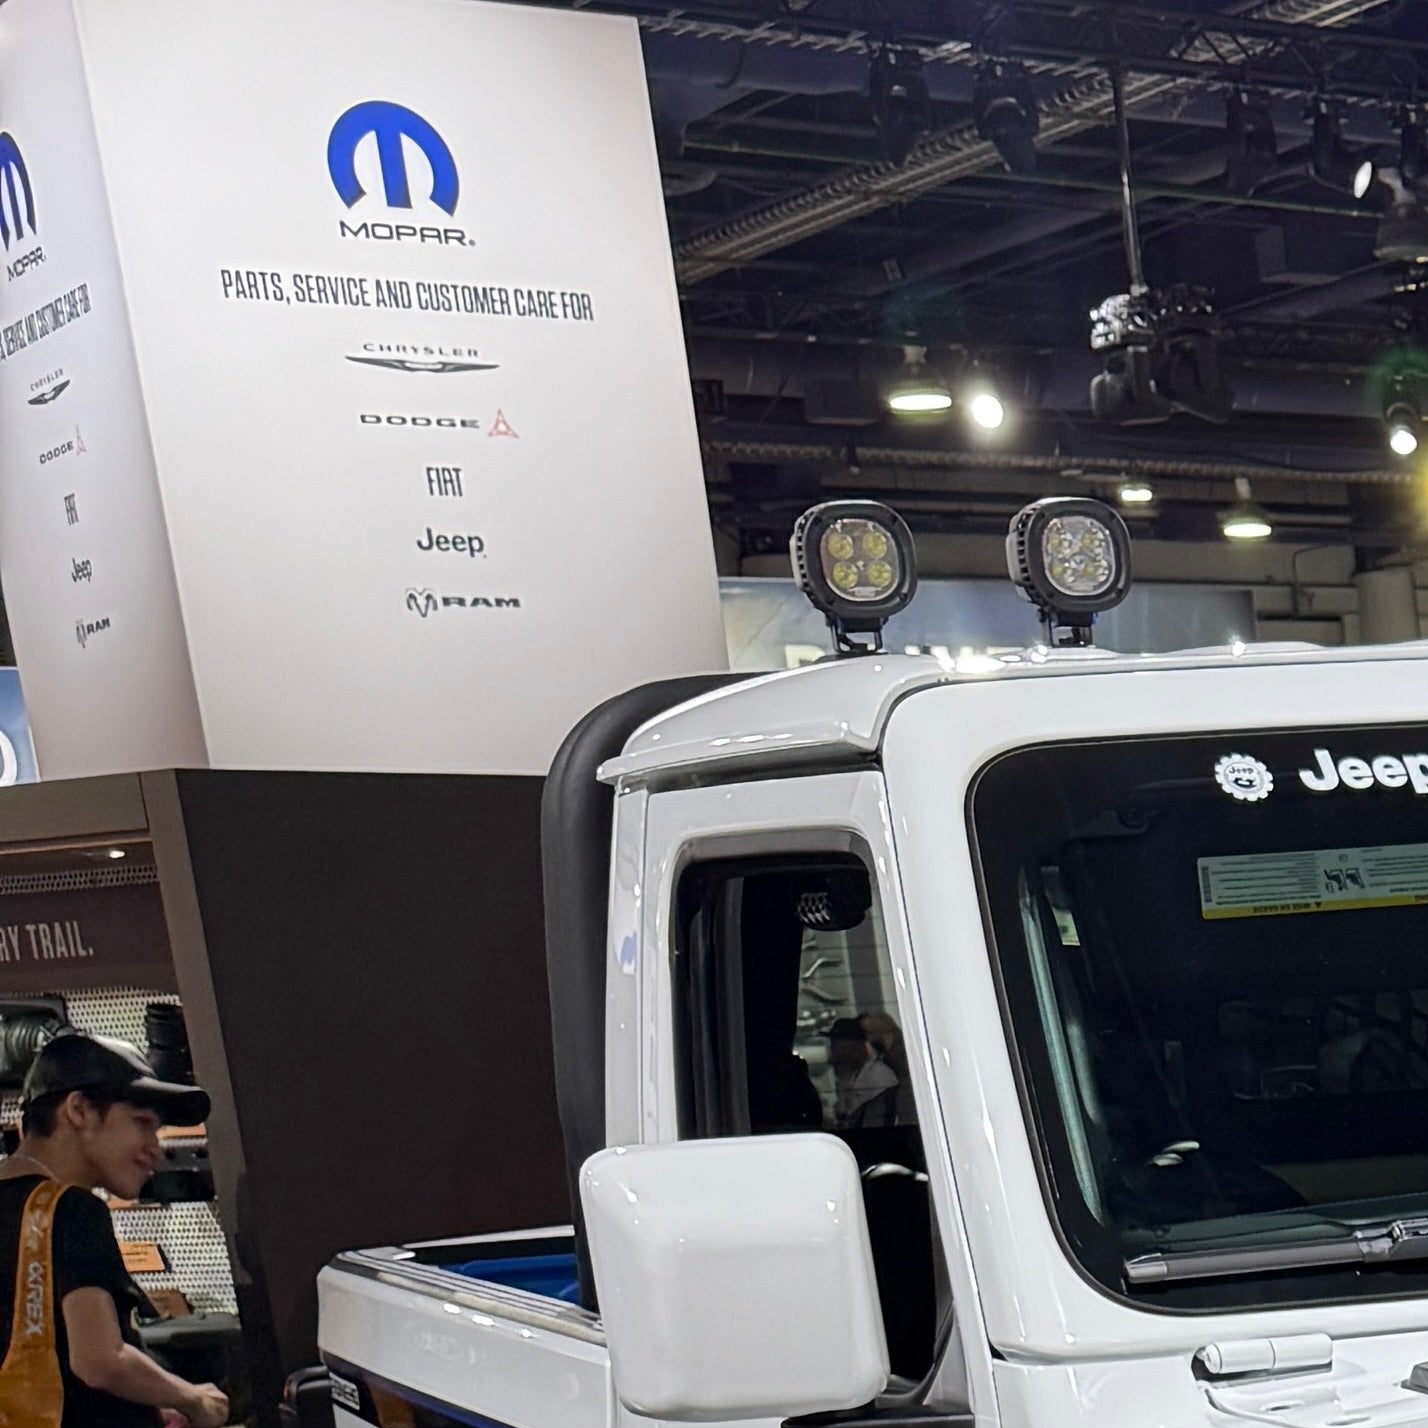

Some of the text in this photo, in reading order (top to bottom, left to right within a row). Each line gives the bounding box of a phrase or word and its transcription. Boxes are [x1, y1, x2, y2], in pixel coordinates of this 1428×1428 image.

[220, 269, 595, 321] PARTS, SERVICE AND CUSTOMER CARE FOR
[363, 343, 479, 357] CHRYSLER
[360, 414, 480, 428] DODGE
[39, 441, 74, 464] DODGE
[426, 467, 463, 497] FIAT
[416, 527, 484, 558] Jeep
[71, 558, 92, 582] Jeep
[441, 596, 521, 608] RAM
[87, 617, 111, 635] RAM
[25, 920, 94, 960] TRAIL.
